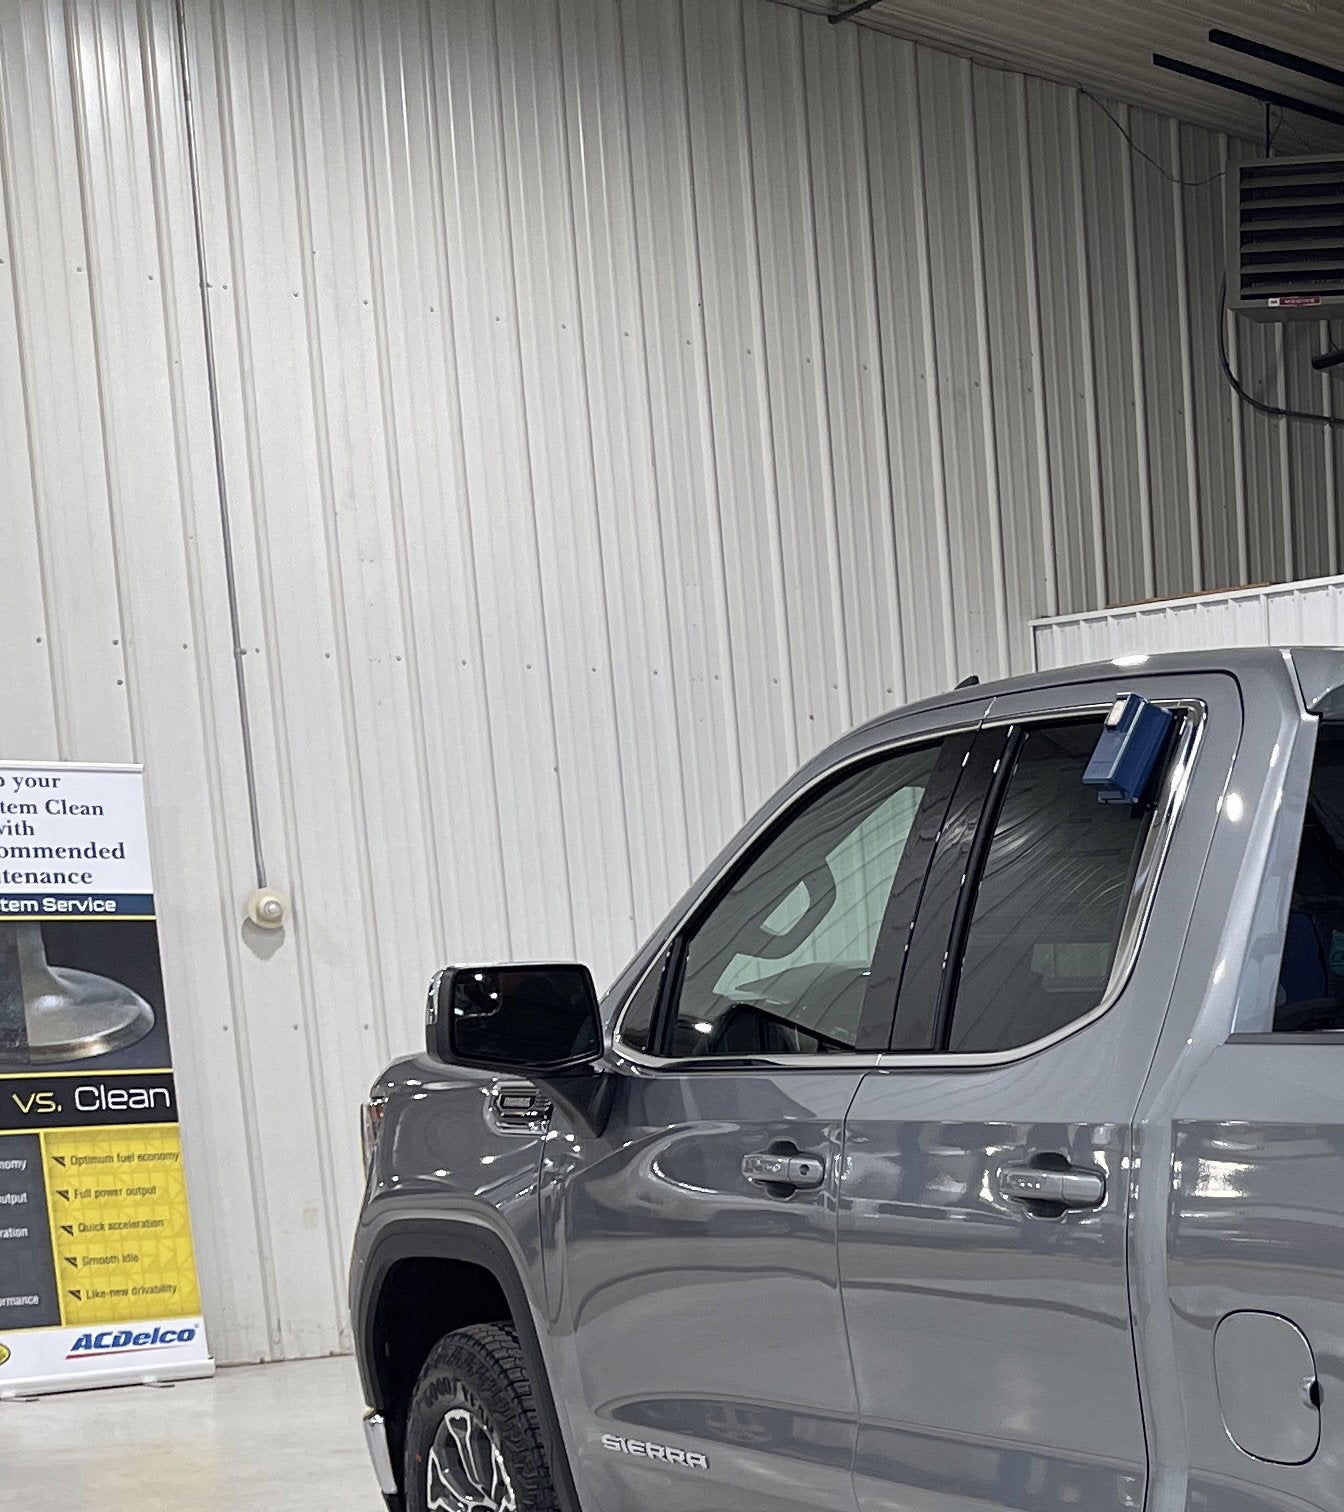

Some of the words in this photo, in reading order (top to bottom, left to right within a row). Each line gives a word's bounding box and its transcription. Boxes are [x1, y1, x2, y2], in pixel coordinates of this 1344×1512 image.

[12, 776, 61, 793] your
[45, 799, 104, 816] Clean
[42, 897, 117, 912] Service
[12, 1092, 62, 1113] vs.
[74, 1084, 171, 1111] Clean
[70, 1154, 114, 1166] Optimum
[117, 1152, 135, 1163] fuel
[137, 1151, 180, 1163] economy
[74, 1188, 92, 1199] Full
[94, 1188, 123, 1199] power
[126, 1184, 157, 1197] output
[78, 1221, 106, 1233] Quick
[108, 1218, 165, 1231] acceleration
[82, 1254, 120, 1266] Smooth
[70, 1327, 196, 1351] ACDelco
[601, 1433, 710, 1470] SIERRA
